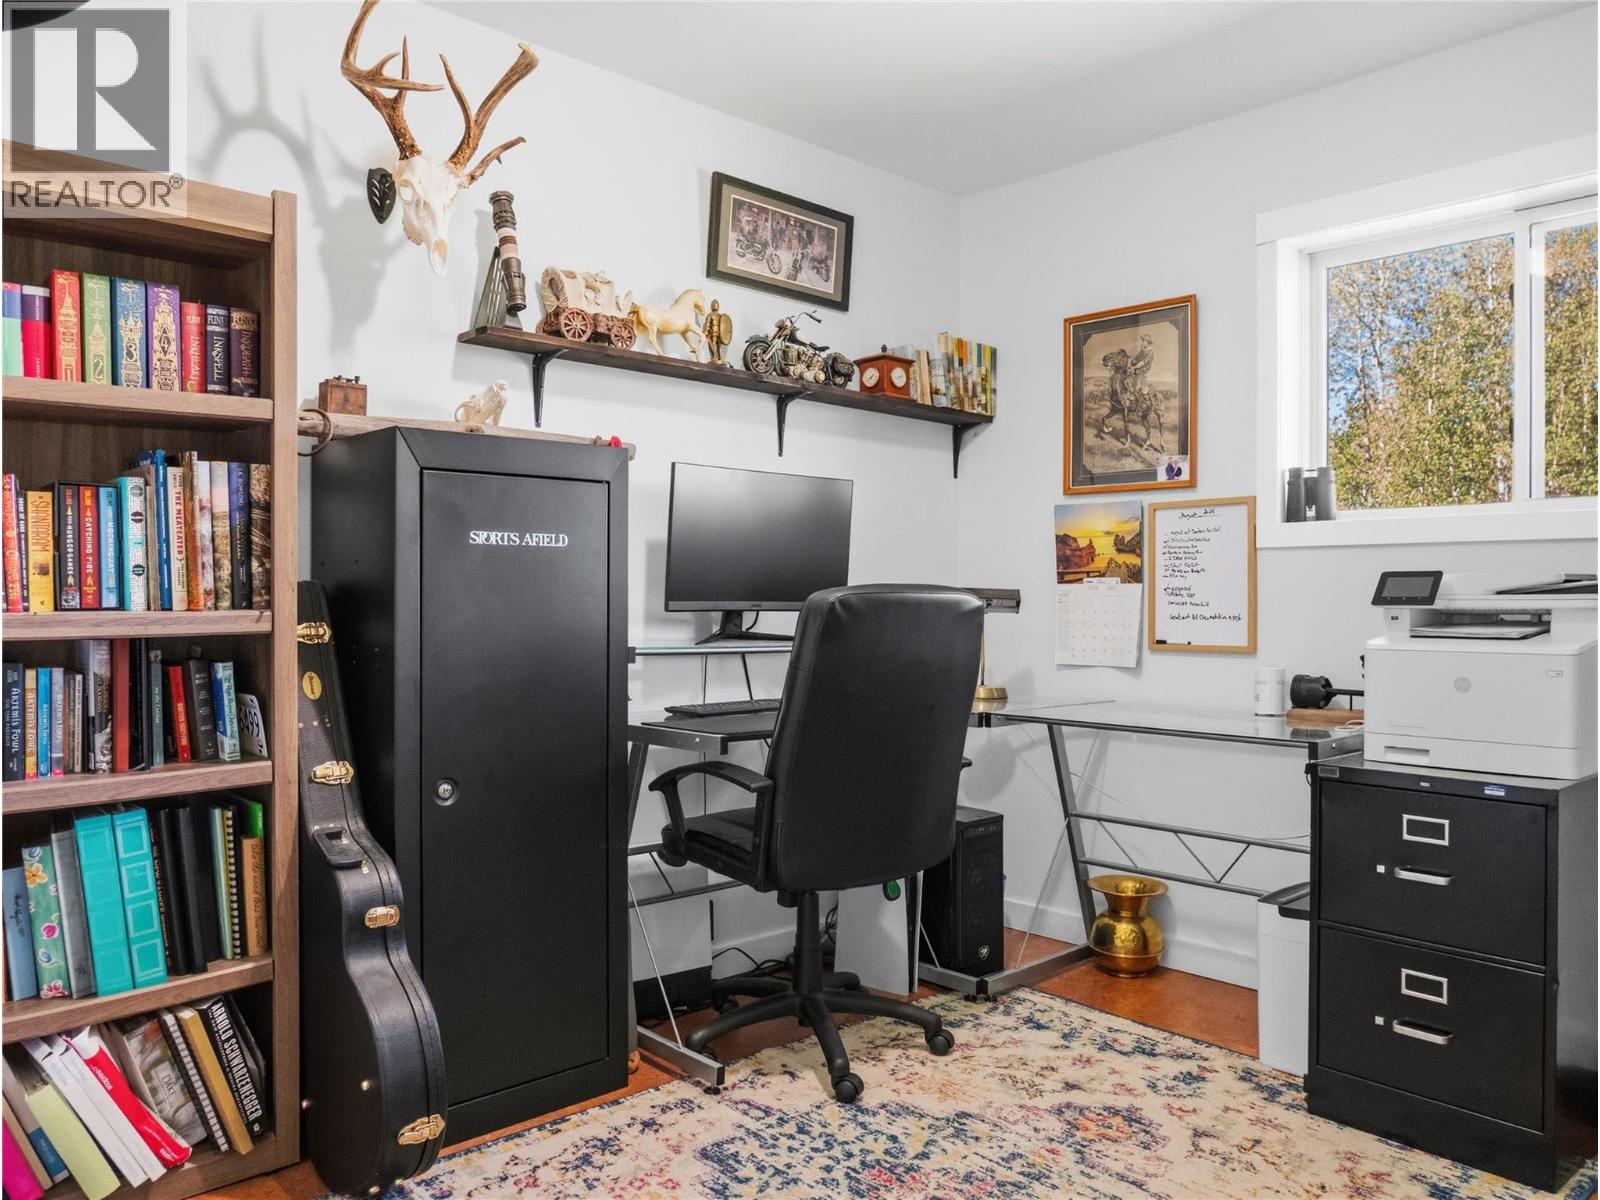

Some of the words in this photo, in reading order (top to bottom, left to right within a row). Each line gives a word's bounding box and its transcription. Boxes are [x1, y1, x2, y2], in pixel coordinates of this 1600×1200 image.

[212, 336, 224, 381] INKSPELL
[240, 331, 253, 377] INKDEATH
[30, 500, 51, 552] SHANTARAM
[85, 517, 93, 554] CATCHING
[175, 508, 184, 555] MEATEATER
[469, 530, 520, 546] SPORTS
[521, 532, 569, 547] AFIELD
[107, 521, 115, 573] MOCKINGJAY
[11, 687, 20, 726] ARTEMIS
[27, 692, 35, 728] ARTEMIS
[12, 728, 20, 752] FOWL
[28, 729, 36, 753] FOWL
[156, 879, 165, 913] YANKEE
[211, 1001, 233, 1040] ARNOLD
[224, 1038, 262, 1122] SCHWARZENEGGER
